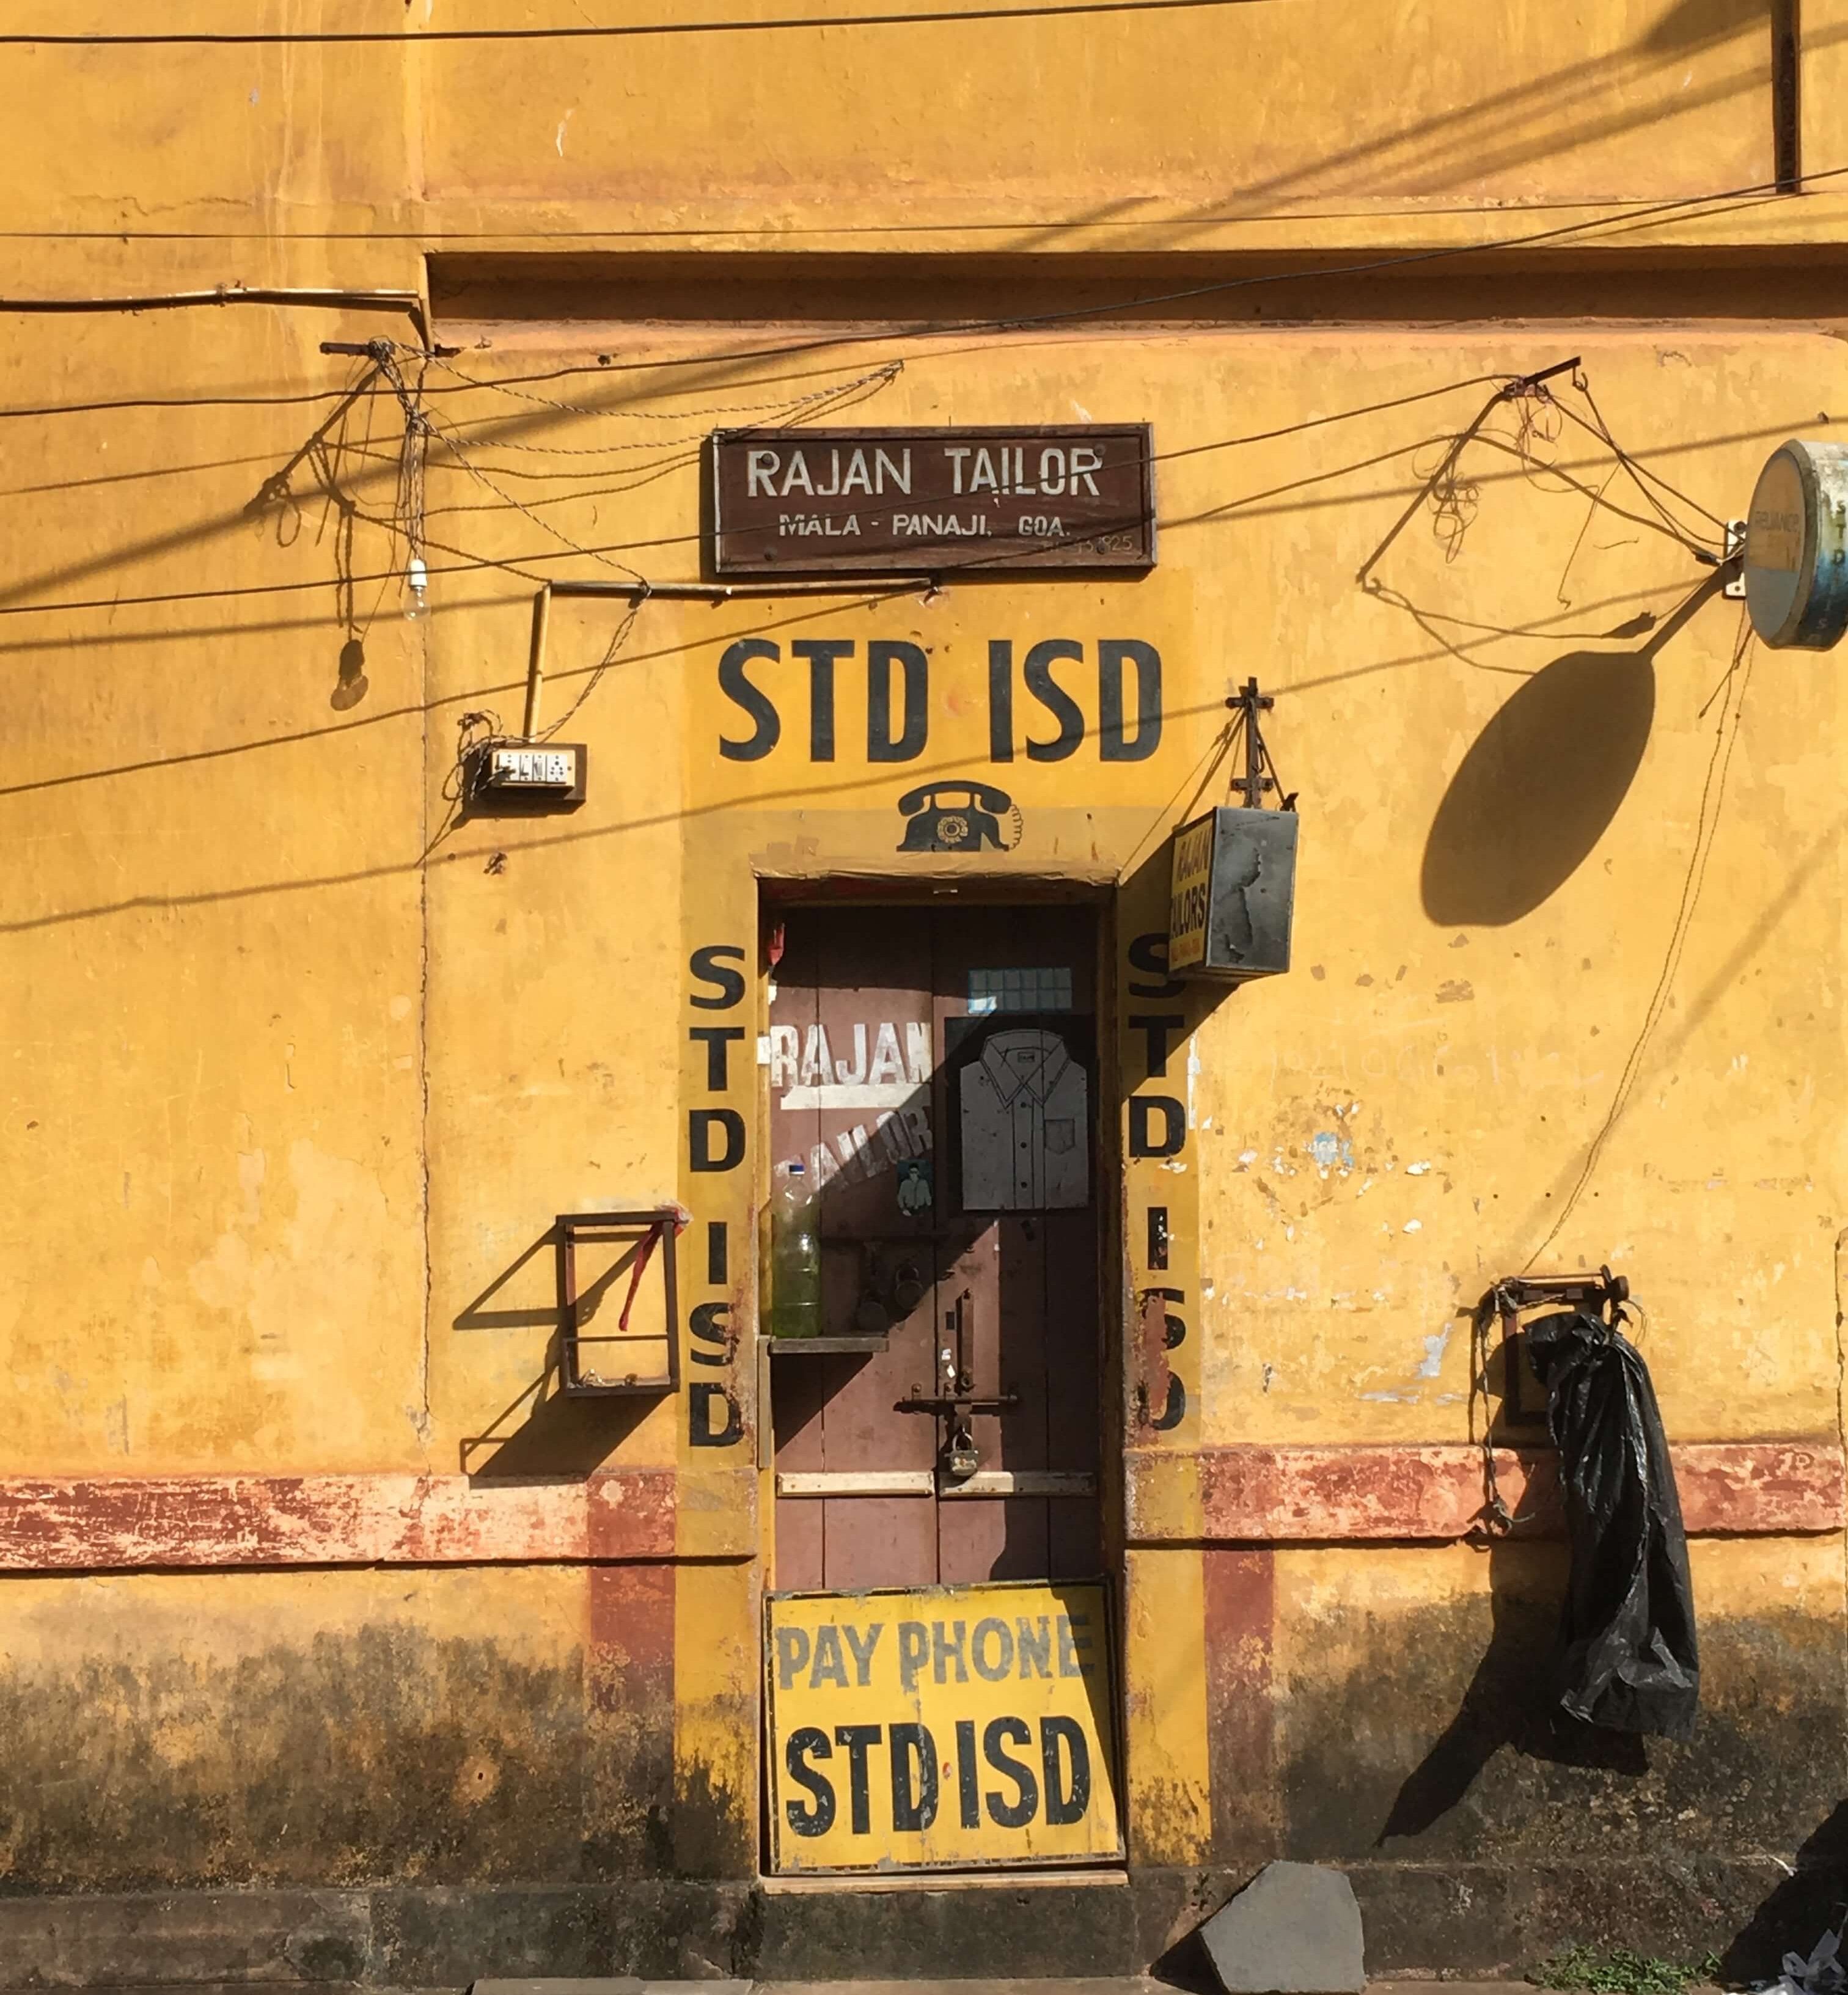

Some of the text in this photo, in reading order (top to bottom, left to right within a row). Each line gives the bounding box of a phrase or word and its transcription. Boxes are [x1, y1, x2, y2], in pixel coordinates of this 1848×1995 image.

[747, 447, 1104, 497] RAJAN TAILOR
[779, 514, 860, 536] MALA
[718, 639, 1163, 763] STD ISD
[689, 945, 746, 1173] STD
[769, 1022, 933, 1088] RAJAN
[774, 1614, 1096, 1693] PAY PHONE
[785, 1715, 1091, 1838] STD ISD
